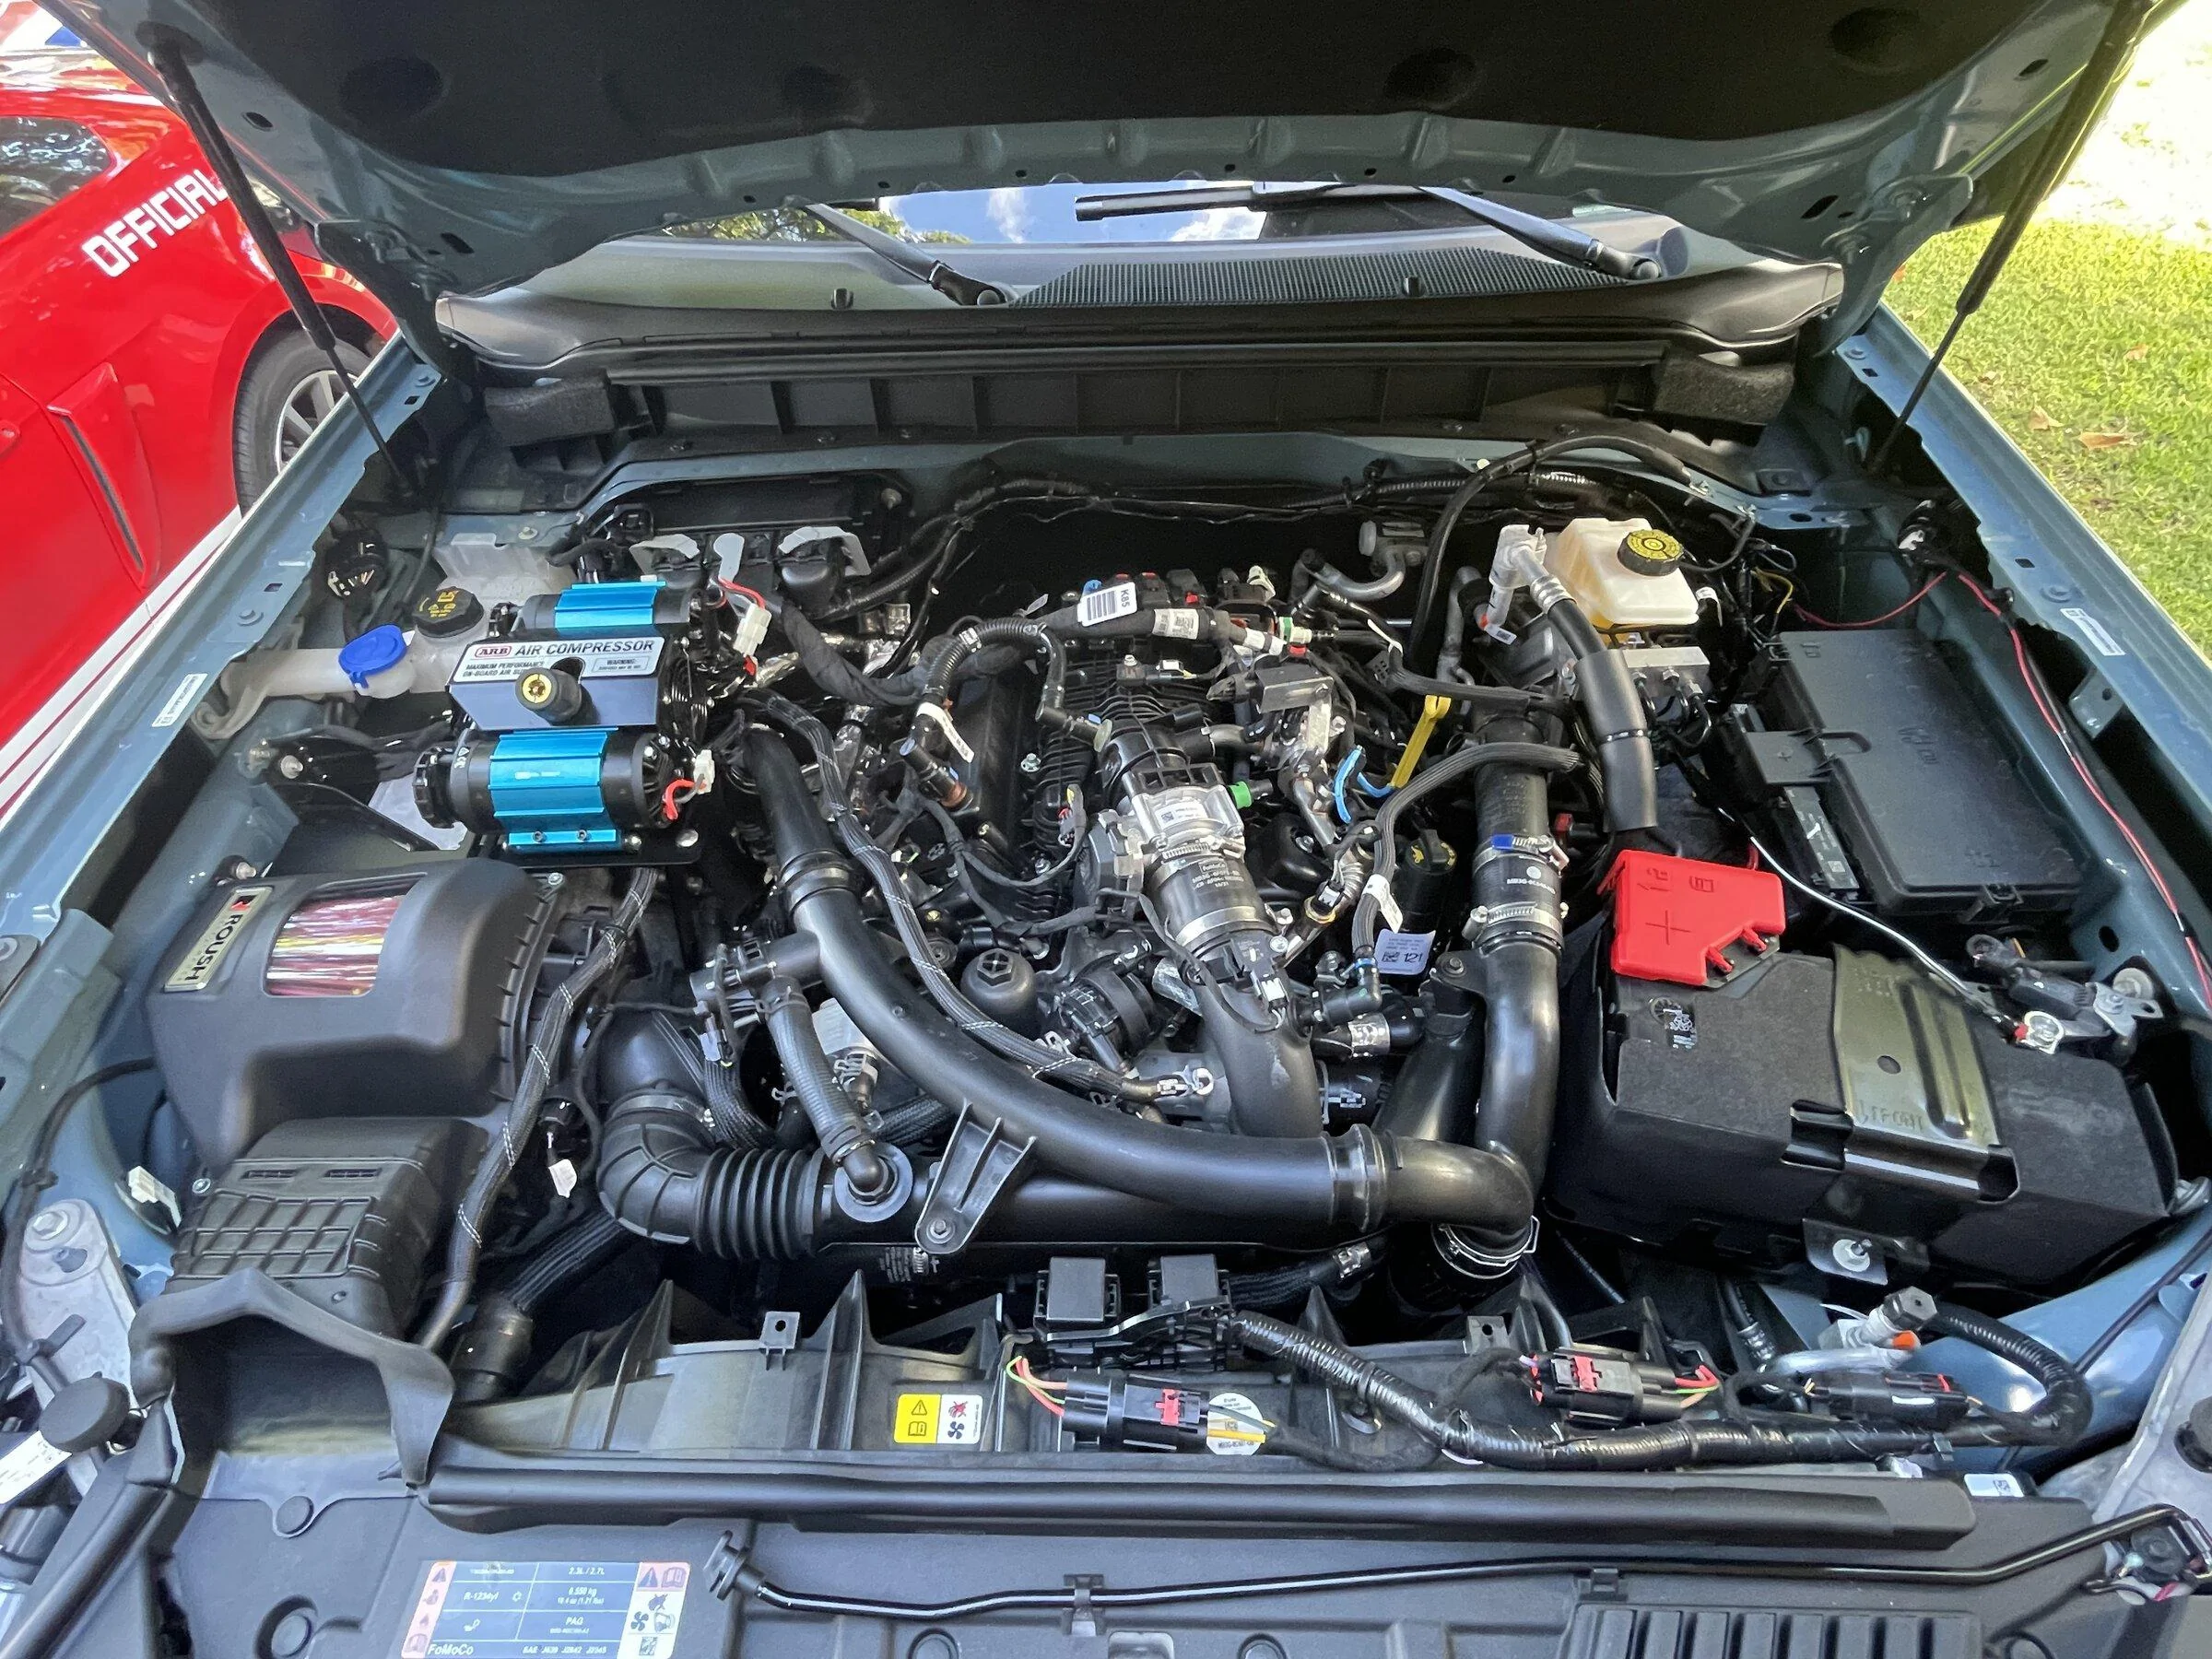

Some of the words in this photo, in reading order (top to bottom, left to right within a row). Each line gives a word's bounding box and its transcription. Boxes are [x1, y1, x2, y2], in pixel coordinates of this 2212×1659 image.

[81, 169, 229, 277] OFFICIAL
[1120, 589, 1131, 607] K85
[478, 647, 509, 656] ARB
[514, 645, 542, 656] AIR
[547, 640, 654, 655] COMPRESSOR
[184, 913, 243, 982] ROUSH
[428, 1644, 474, 1655] FoMoCo
